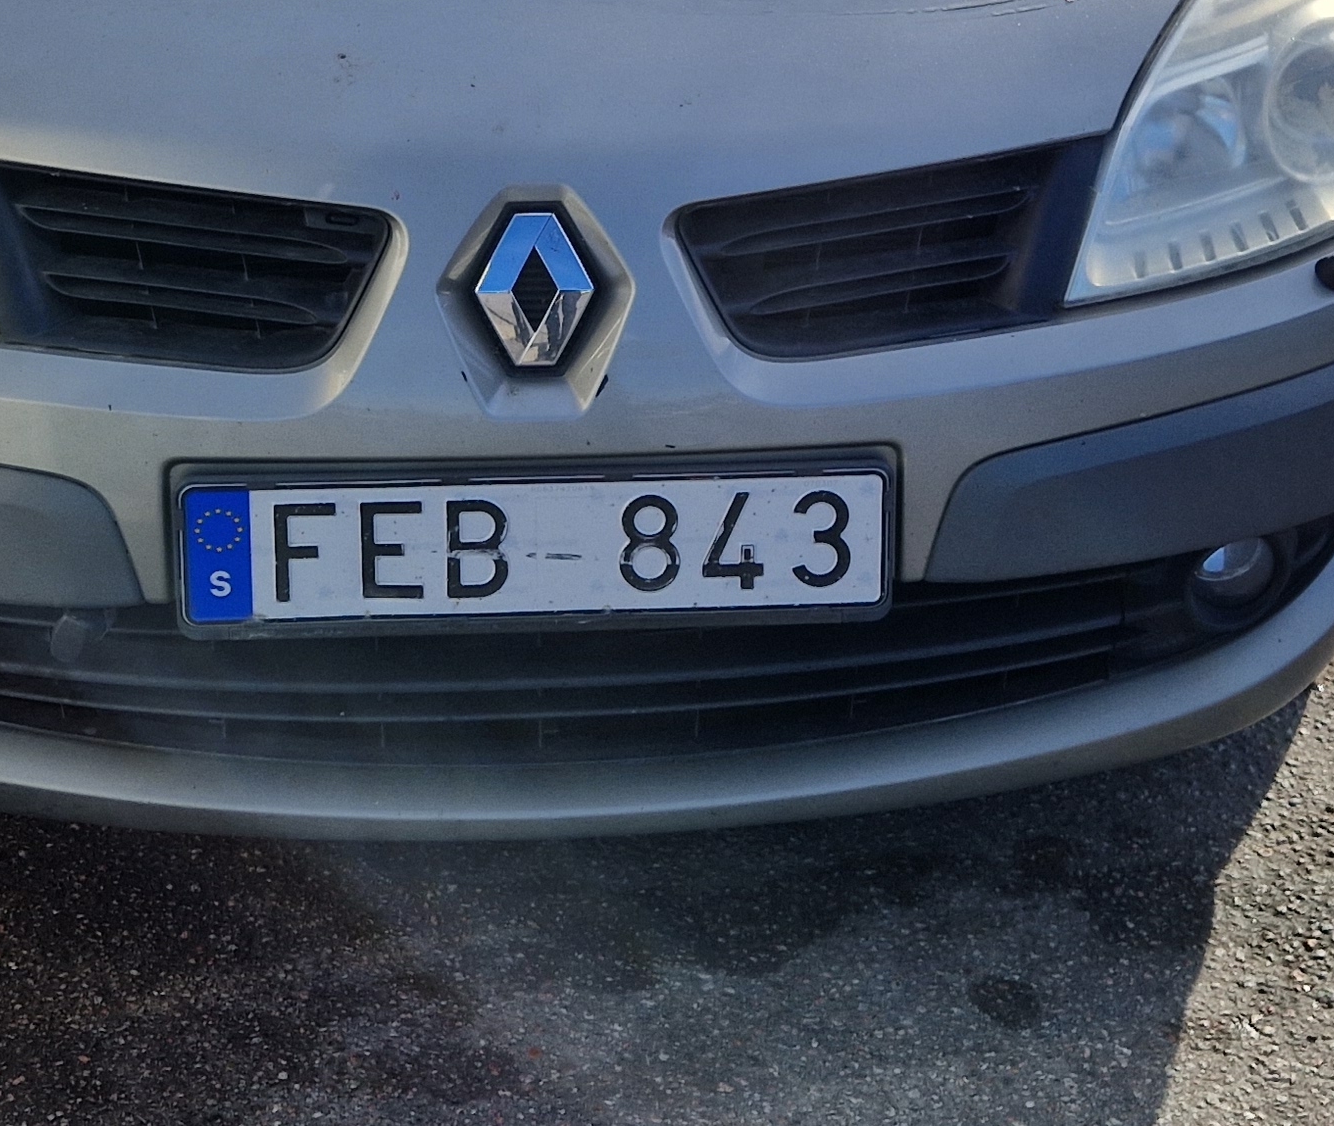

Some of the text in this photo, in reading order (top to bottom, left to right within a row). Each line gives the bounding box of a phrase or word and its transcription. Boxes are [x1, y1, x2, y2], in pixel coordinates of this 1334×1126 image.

[273, 490, 851, 602] FEB 843
[209, 570, 232, 597] S
